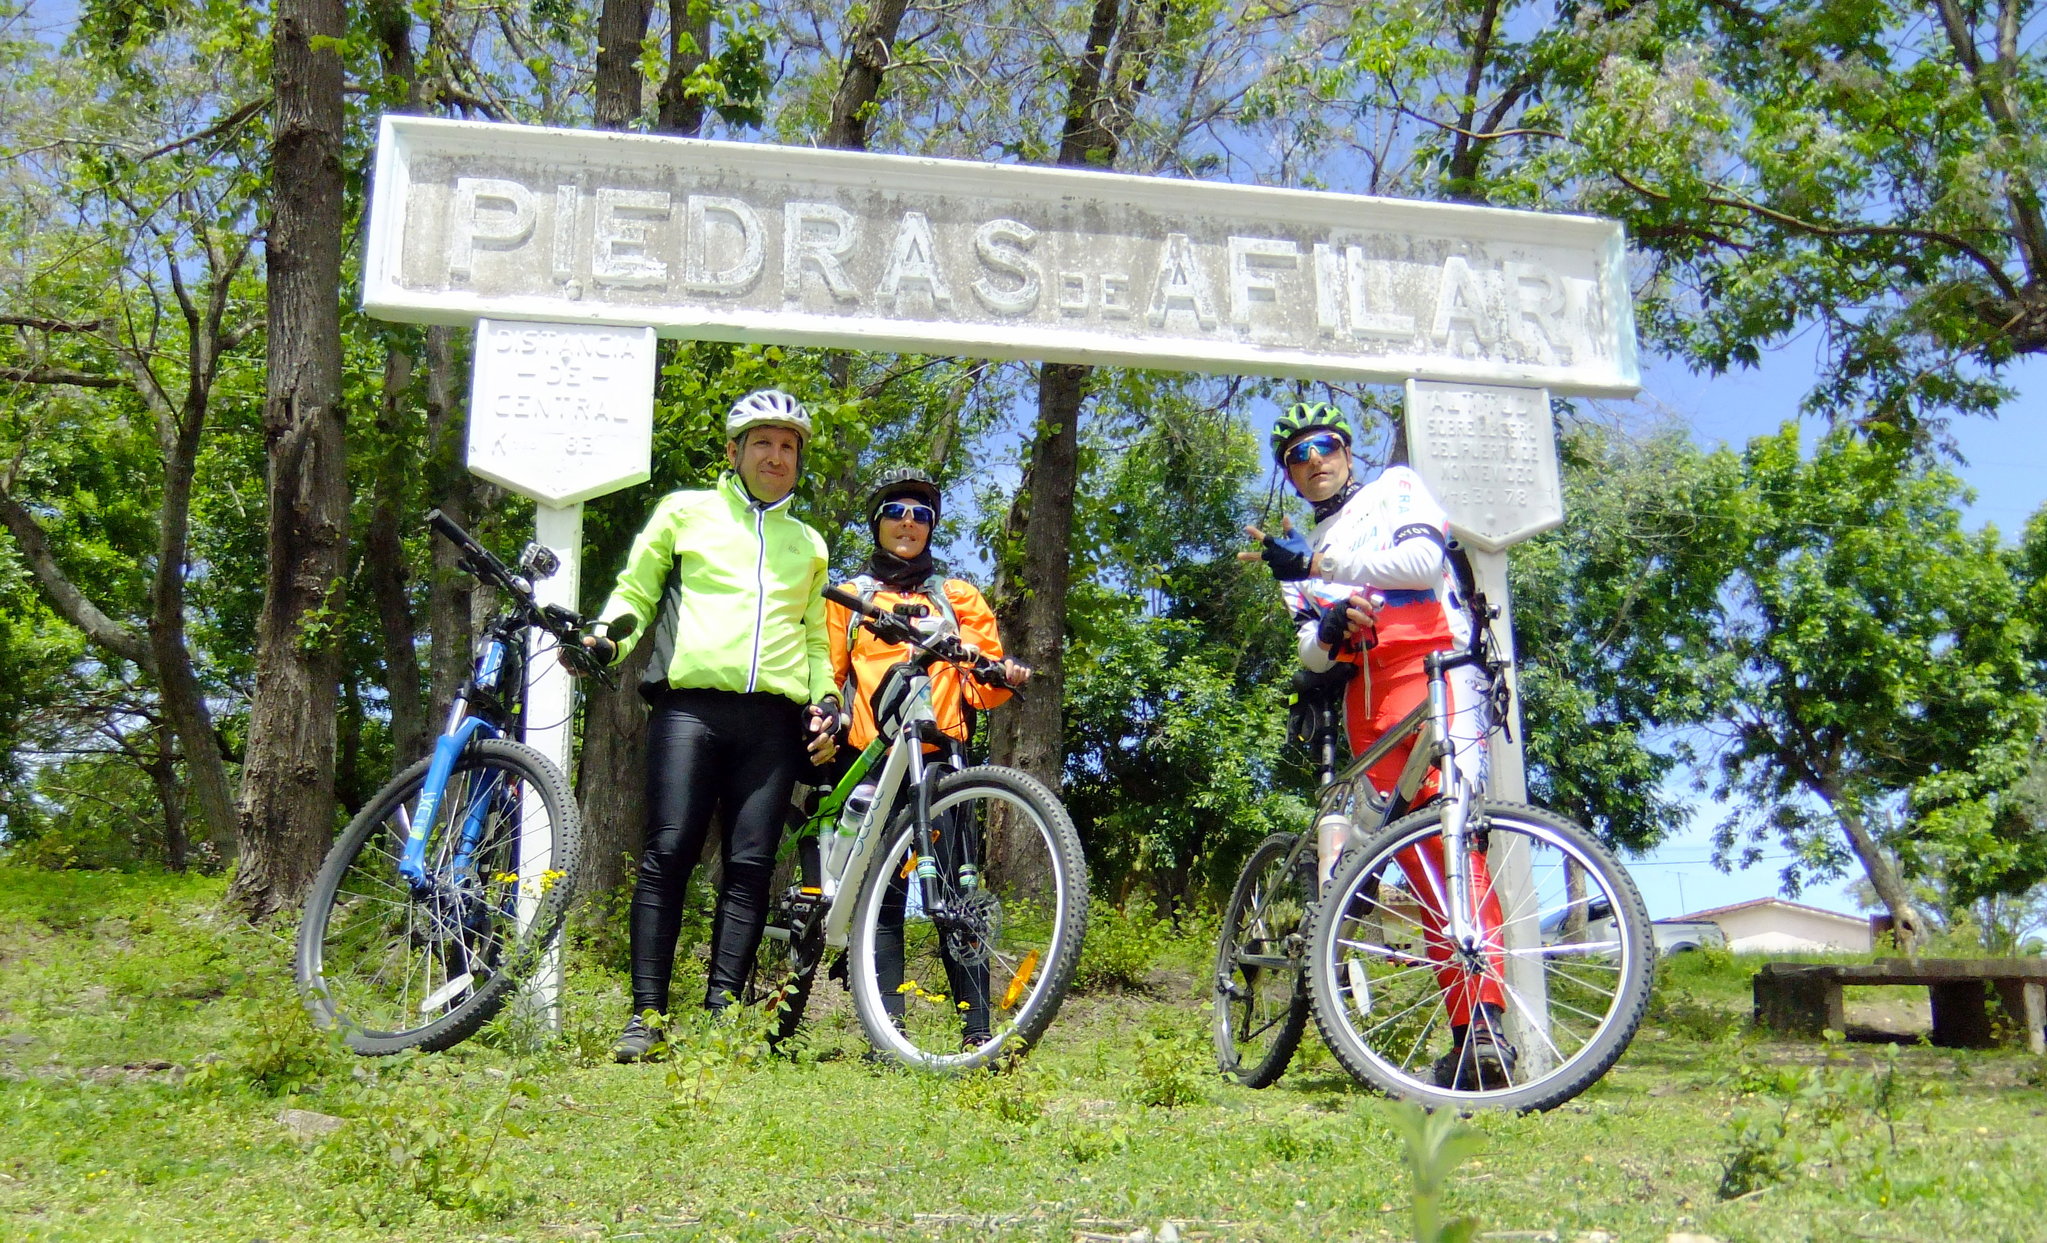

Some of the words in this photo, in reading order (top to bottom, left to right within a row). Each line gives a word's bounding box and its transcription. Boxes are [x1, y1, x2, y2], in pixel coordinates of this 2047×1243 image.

[449, 177, 1041, 318] PIEDRAS
[1059, 272, 1131, 320] DE
[1145, 232, 1575, 352] AFILAR
[495, 330, 636, 360] DISTANCIA
[546, 364, 583, 388] DE
[495, 393, 630, 425] CENTRAL
